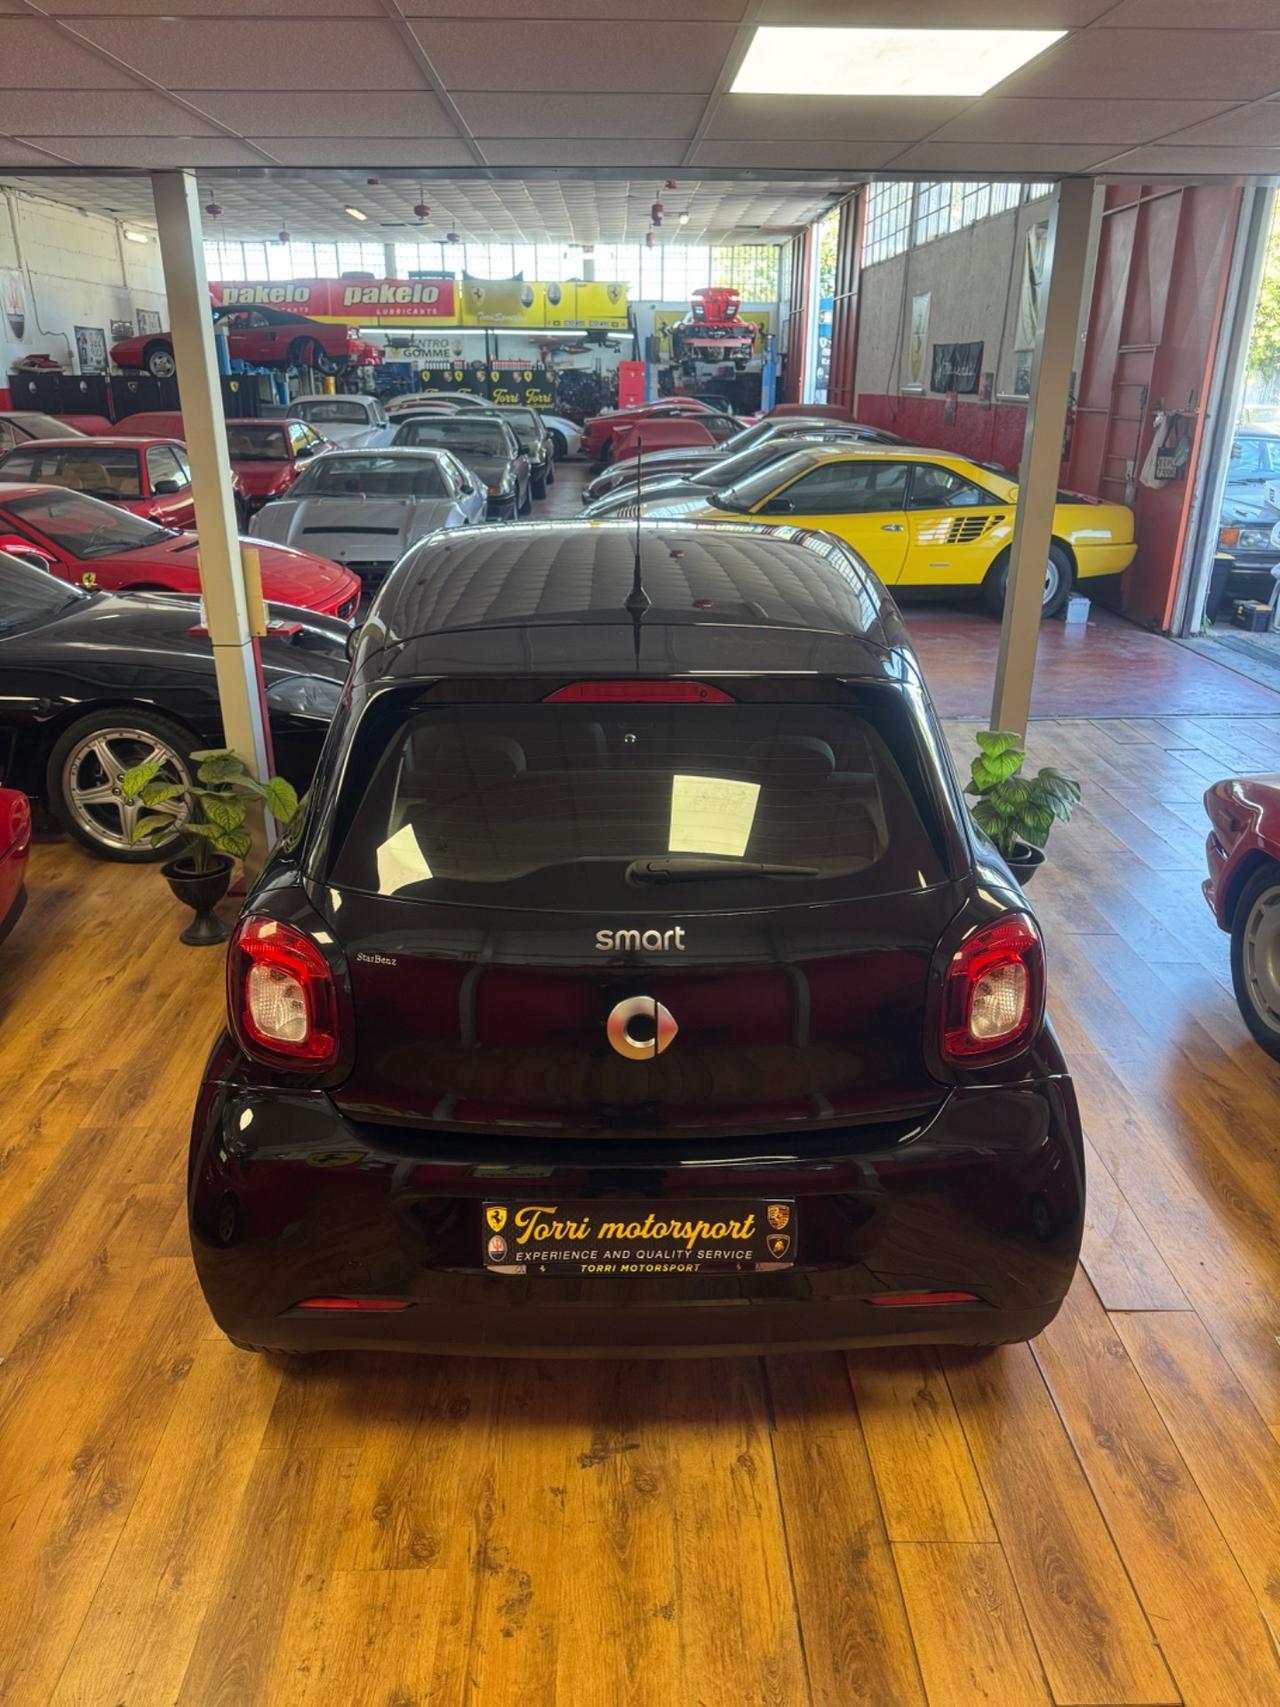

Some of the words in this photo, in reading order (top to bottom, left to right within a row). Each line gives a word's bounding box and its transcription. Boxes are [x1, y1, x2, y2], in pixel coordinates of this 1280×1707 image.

[222, 285, 310, 306] pakelo
[342, 283, 440, 307] pakelo
[376, 308, 438, 316] LUBRICANTS
[403, 348, 450, 358] GOMME
[492, 388, 519, 404] Torri
[525, 388, 552, 404] Torri
[595, 926, 685, 951] smart
[514, 1206, 591, 1245] Torri
[597, 1213, 756, 1250] motorsport
[515, 1250, 598, 1262] EXPERIENCE
[603, 1250, 631, 1260] AND
[636, 1249, 692, 1260] QUALITY
[697, 1249, 753, 1260] SERVICE
[580, 1264, 616, 1273] TORRI
[620, 1263, 700, 1273] MOTORSPORT
